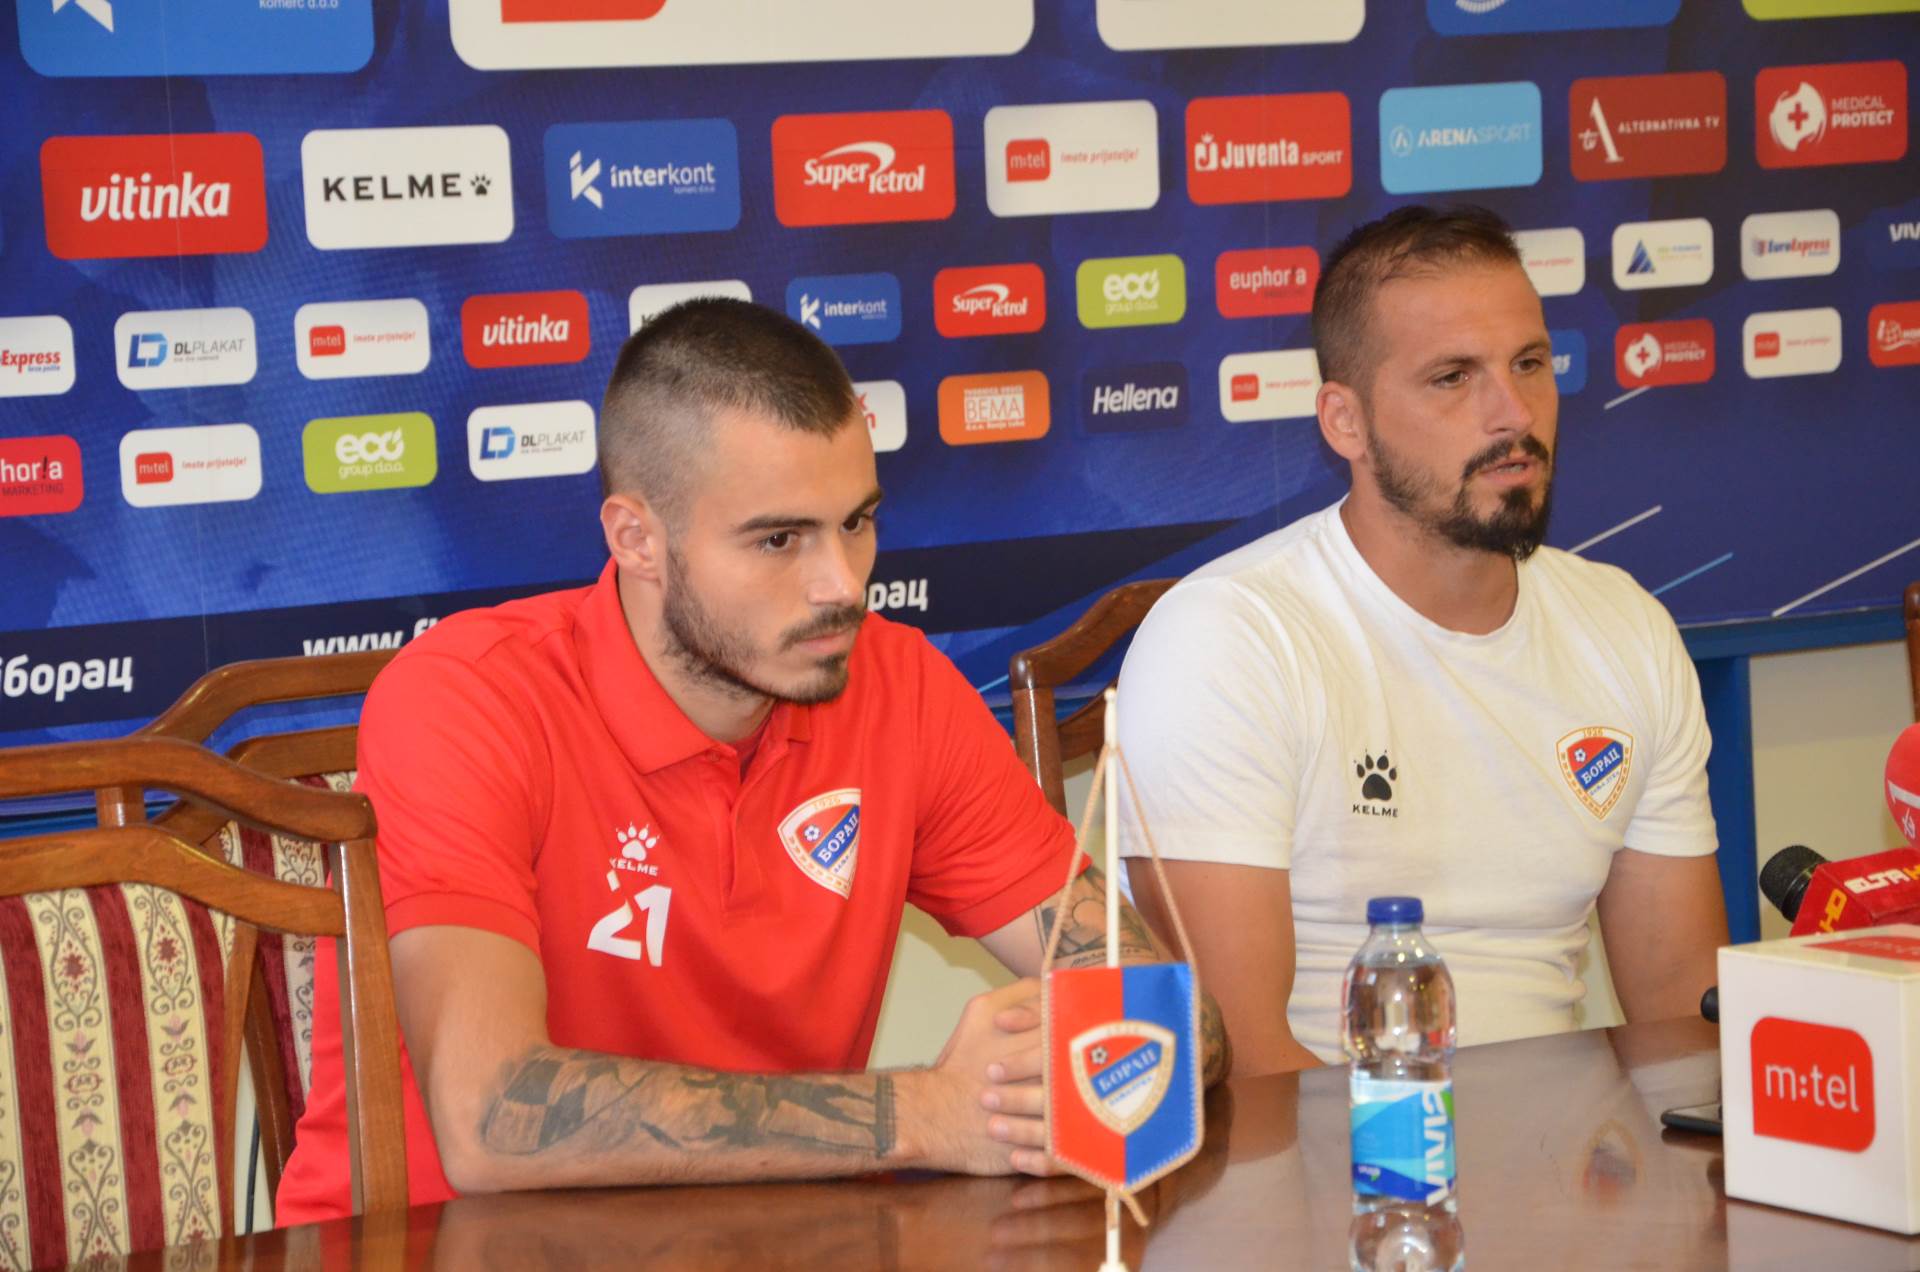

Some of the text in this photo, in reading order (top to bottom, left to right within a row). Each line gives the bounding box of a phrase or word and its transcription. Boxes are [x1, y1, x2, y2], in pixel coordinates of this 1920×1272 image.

[1831, 96, 1885, 110] MEDICAL
[1704, 115, 1720, 128] TV
[1831, 110, 1894, 128] PROTECT
[1221, 138, 1342, 170] Juventa SPORT
[323, 173, 462, 202] KELME
[610, 162, 716, 188] interkont
[803, 158, 870, 191] Super
[80, 172, 231, 222] vitinka
[1104, 269, 1160, 301] eco
[824, 299, 887, 318] interkont
[952, 293, 994, 316] Super
[482, 314, 569, 347] vitinka
[0, 350, 61, 374] Express
[966, 398, 1023, 421] BEMA
[1093, 383, 1178, 415] Hellena
[335, 426, 405, 465] eco
[1581, 747, 1620, 785] БОРАЦ
[1352, 803, 1399, 818] KELME
[609, 857, 659, 876] KELME
[586, 869, 672, 967] 21
[1765, 1062, 1860, 1113] m:tel
